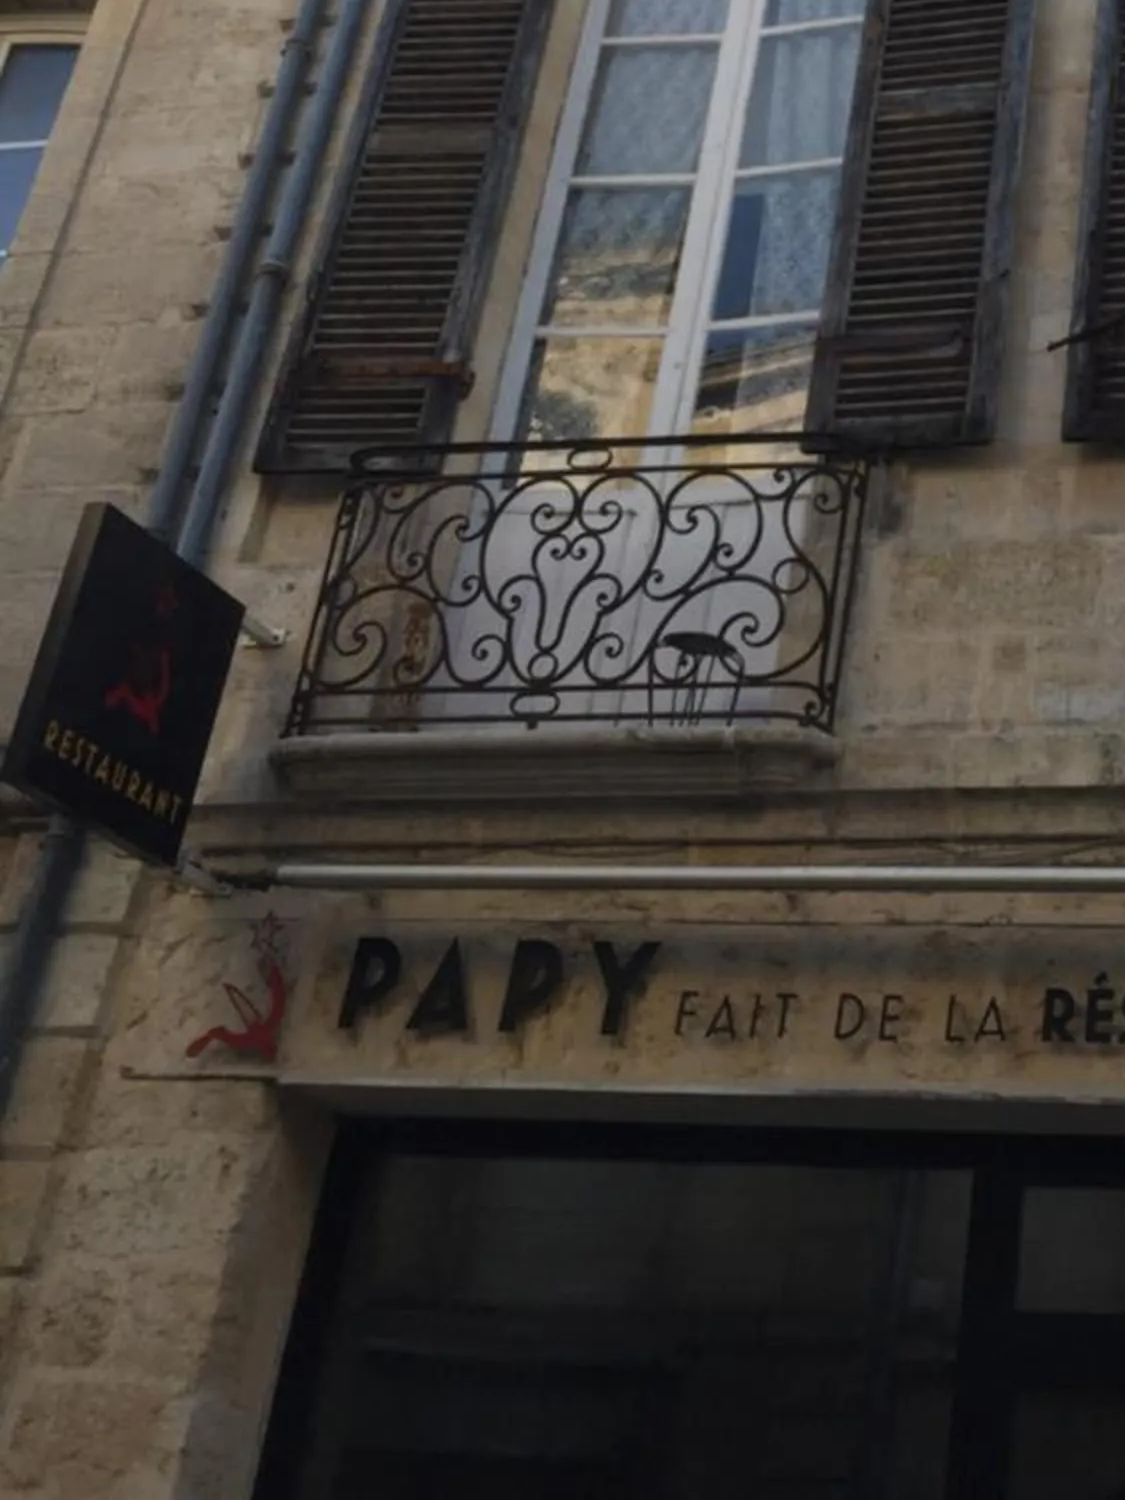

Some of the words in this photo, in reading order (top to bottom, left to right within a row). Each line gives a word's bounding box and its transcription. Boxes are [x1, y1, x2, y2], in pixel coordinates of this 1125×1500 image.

[45, 719, 182, 823] RESTAURANT
[338, 937, 662, 1036] PAPY
[674, 990, 799, 1039] FAIT
[834, 992, 904, 1042] DE
[945, 994, 1007, 1043] LA
